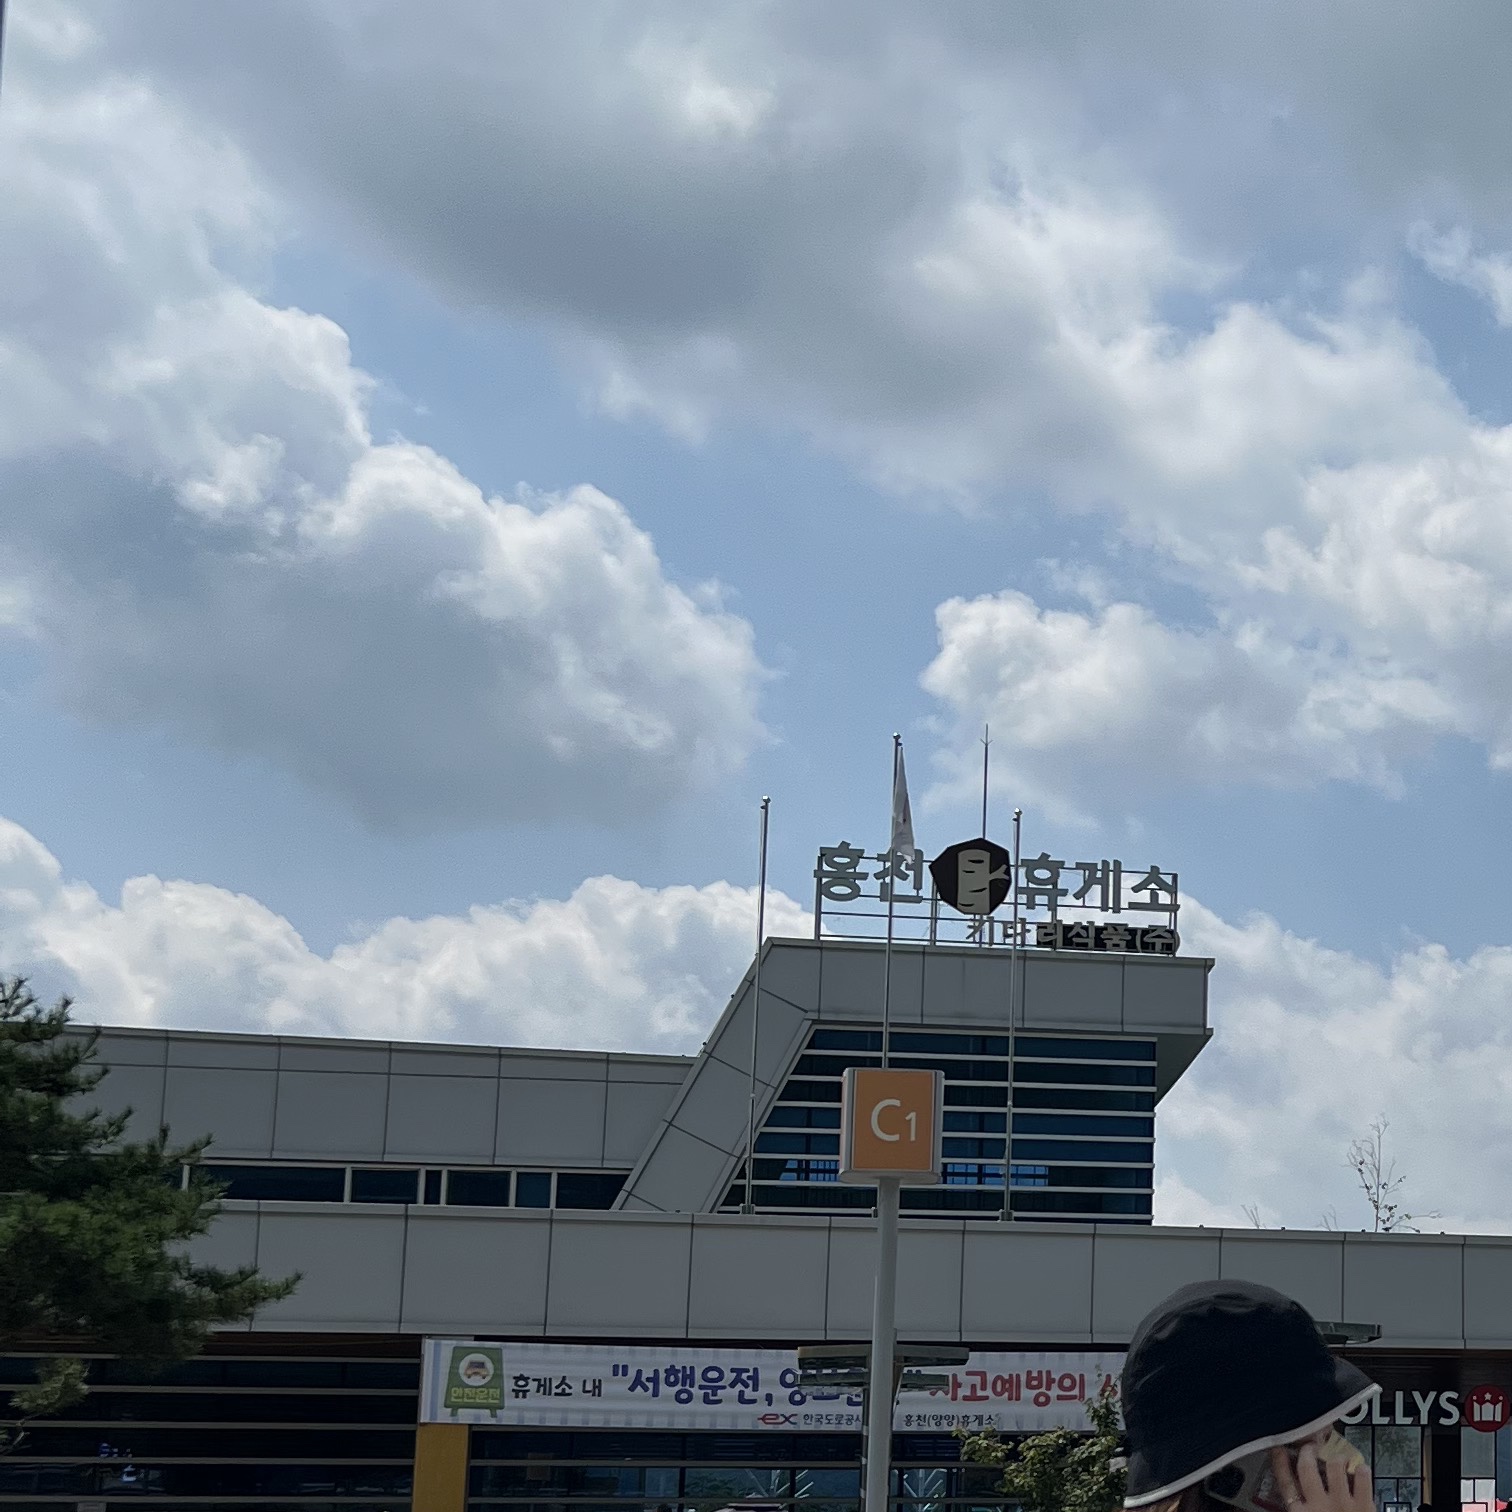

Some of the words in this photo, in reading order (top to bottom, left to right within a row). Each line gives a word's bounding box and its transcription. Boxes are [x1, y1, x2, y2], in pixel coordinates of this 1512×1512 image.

[813, 840, 924, 904] 홍천
[1017, 852, 1181, 914] 휴게소
[966, 916, 1181, 956] 키다리식품(주)
[870, 1098, 917, 1142] C1
[511, 1373, 573, 1399] 휴게소
[581, 1377, 603, 1398] 내
[903, 1412, 996, 1428] 홍천(양양)휴게소
